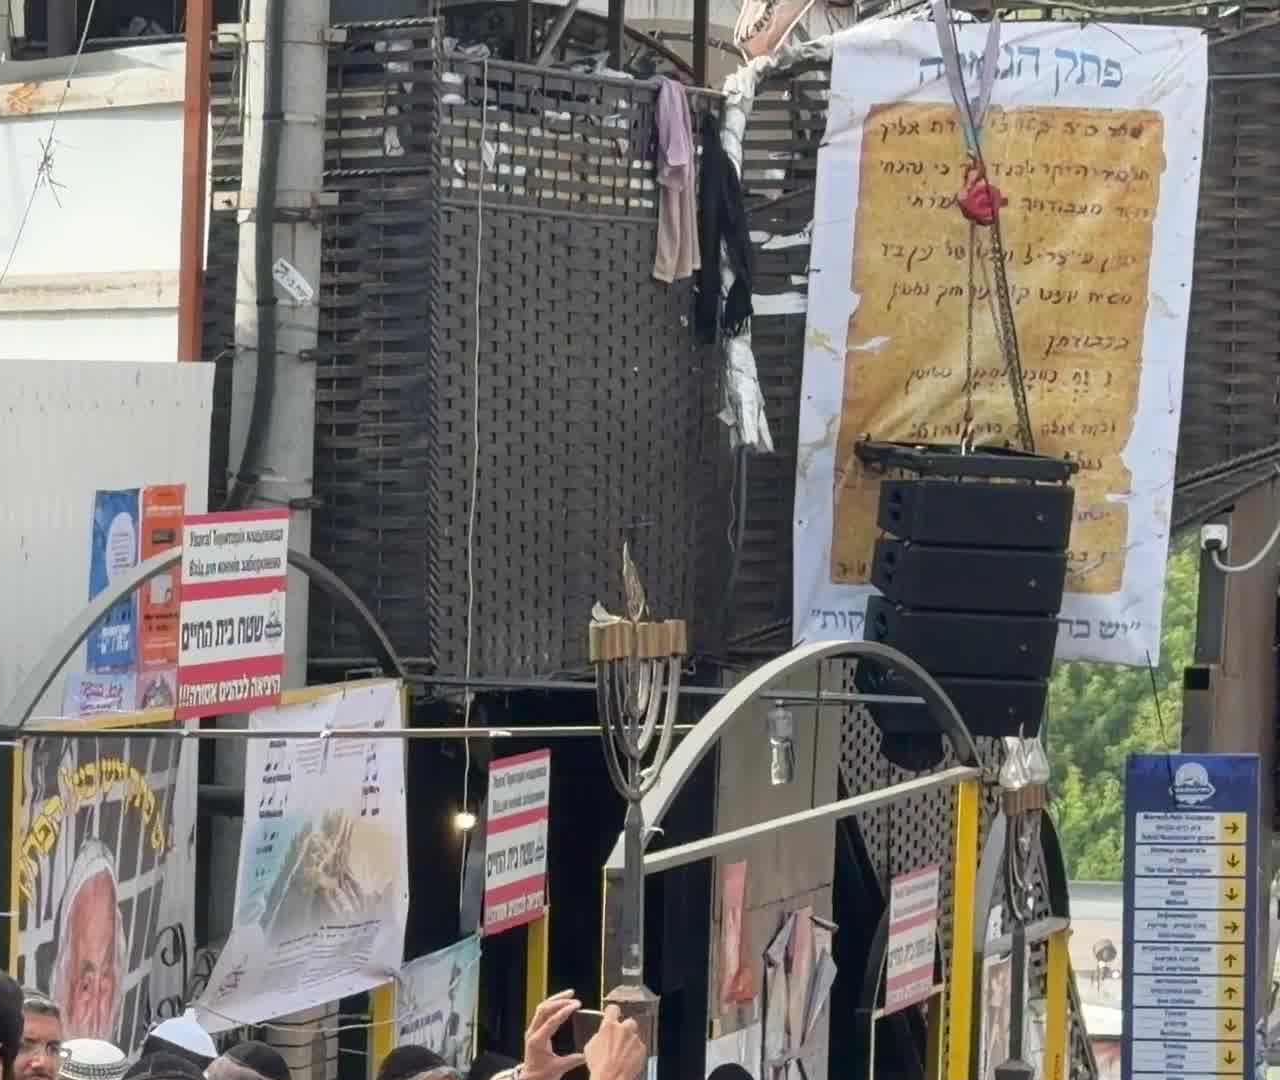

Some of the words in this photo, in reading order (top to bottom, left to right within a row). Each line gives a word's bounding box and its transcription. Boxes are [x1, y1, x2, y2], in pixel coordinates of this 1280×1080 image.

[1054, 47, 1124, 96] פתק
[181, 620, 212, 651] החיים
[214, 617, 234, 647] בית
[238, 614, 265, 644] שטח
